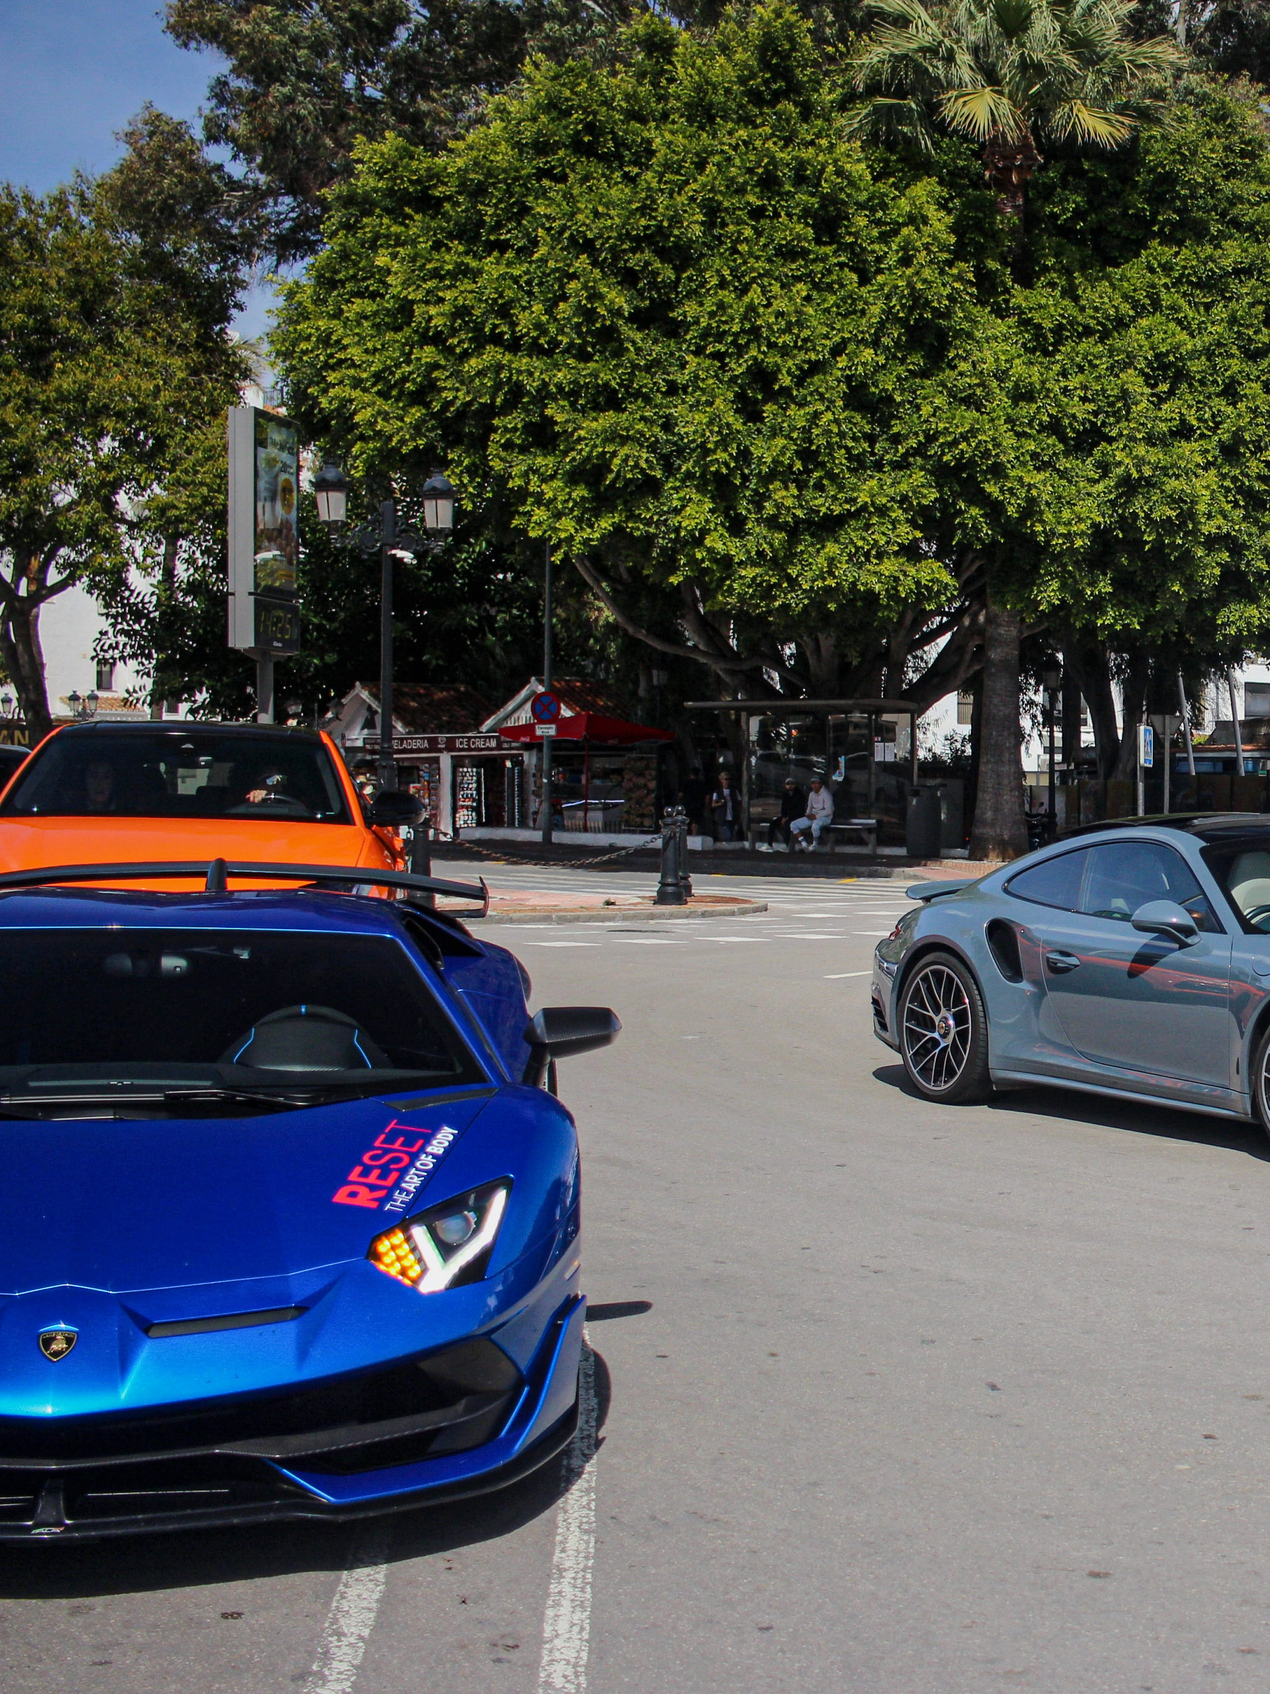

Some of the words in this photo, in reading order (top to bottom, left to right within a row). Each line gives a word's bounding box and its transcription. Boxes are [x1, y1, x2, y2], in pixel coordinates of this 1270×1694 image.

[391, 739, 429, 749] ELADERIA
[456, 739, 468, 748] ICE
[470, 738, 497, 748] CREAM
[426, 1125, 459, 1155] BODY
[331, 1118, 433, 1209] RESET
[415, 1153, 438, 1170] OF
[400, 1167, 428, 1193] ART
[383, 1189, 414, 1212] THE
